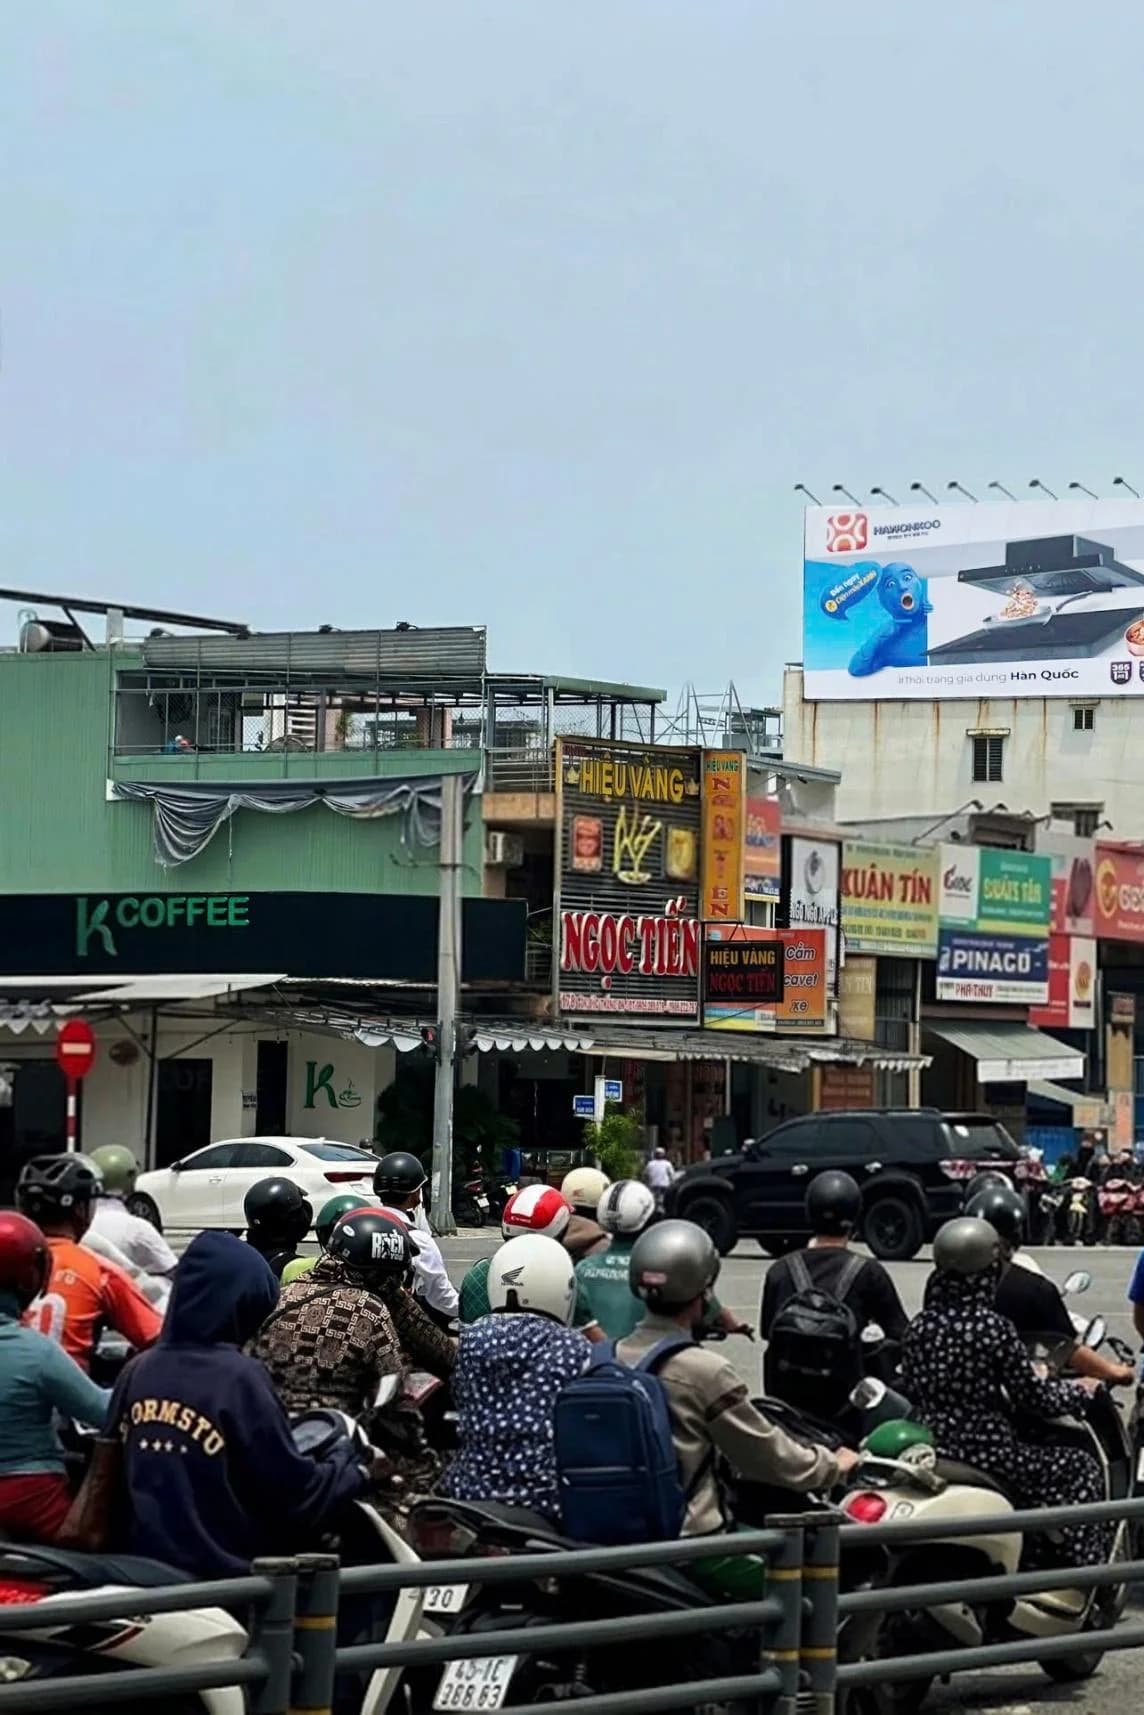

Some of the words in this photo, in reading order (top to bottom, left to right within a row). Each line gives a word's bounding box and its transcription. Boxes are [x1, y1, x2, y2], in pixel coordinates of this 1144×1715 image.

[1010, 669, 1037, 681] Hàn
[1041, 667, 1080, 681] Quốc
[579, 752, 627, 802] HIỆU
[898, 867, 932, 905] TÍN
[116, 896, 250, 927] COFFEE
[560, 911, 636, 990] NGỌC
[637, 895, 700, 977] TIẾN
[709, 948, 739, 969] HIỆU
[741, 947, 776, 966] VÀNG
[952, 949, 1031, 973] PINACO
[784, 973, 818, 987] cavet
[303, 1061, 340, 1109] K
